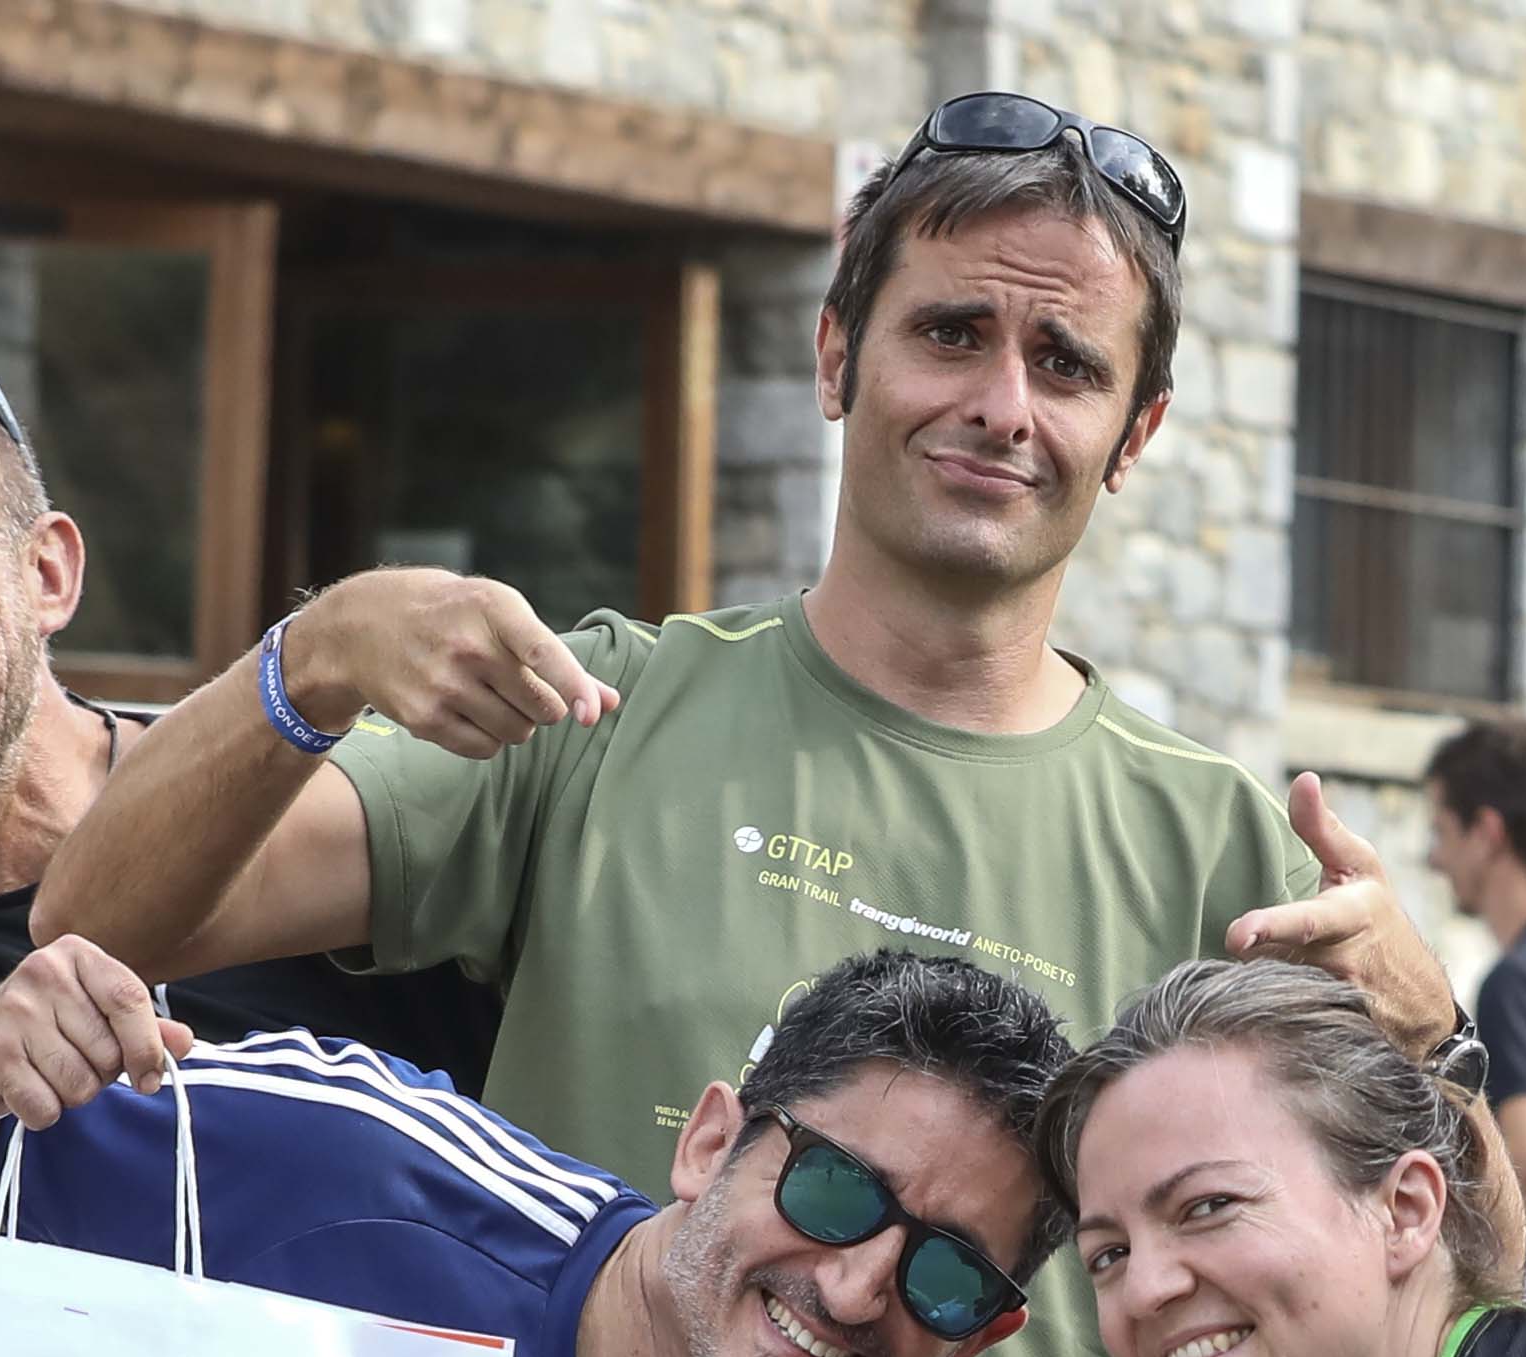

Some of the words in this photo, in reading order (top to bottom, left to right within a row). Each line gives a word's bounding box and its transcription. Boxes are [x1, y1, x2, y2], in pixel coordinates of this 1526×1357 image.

[293, 727, 315, 744] DE
[767, 834, 853, 876] GTTAP
[758, 870, 799, 892] GRAN
[803, 880, 841, 907] TRAIL
[850, 897, 971, 947] trangoworld
[972, 935, 1076, 988] ANETO-POSETS
